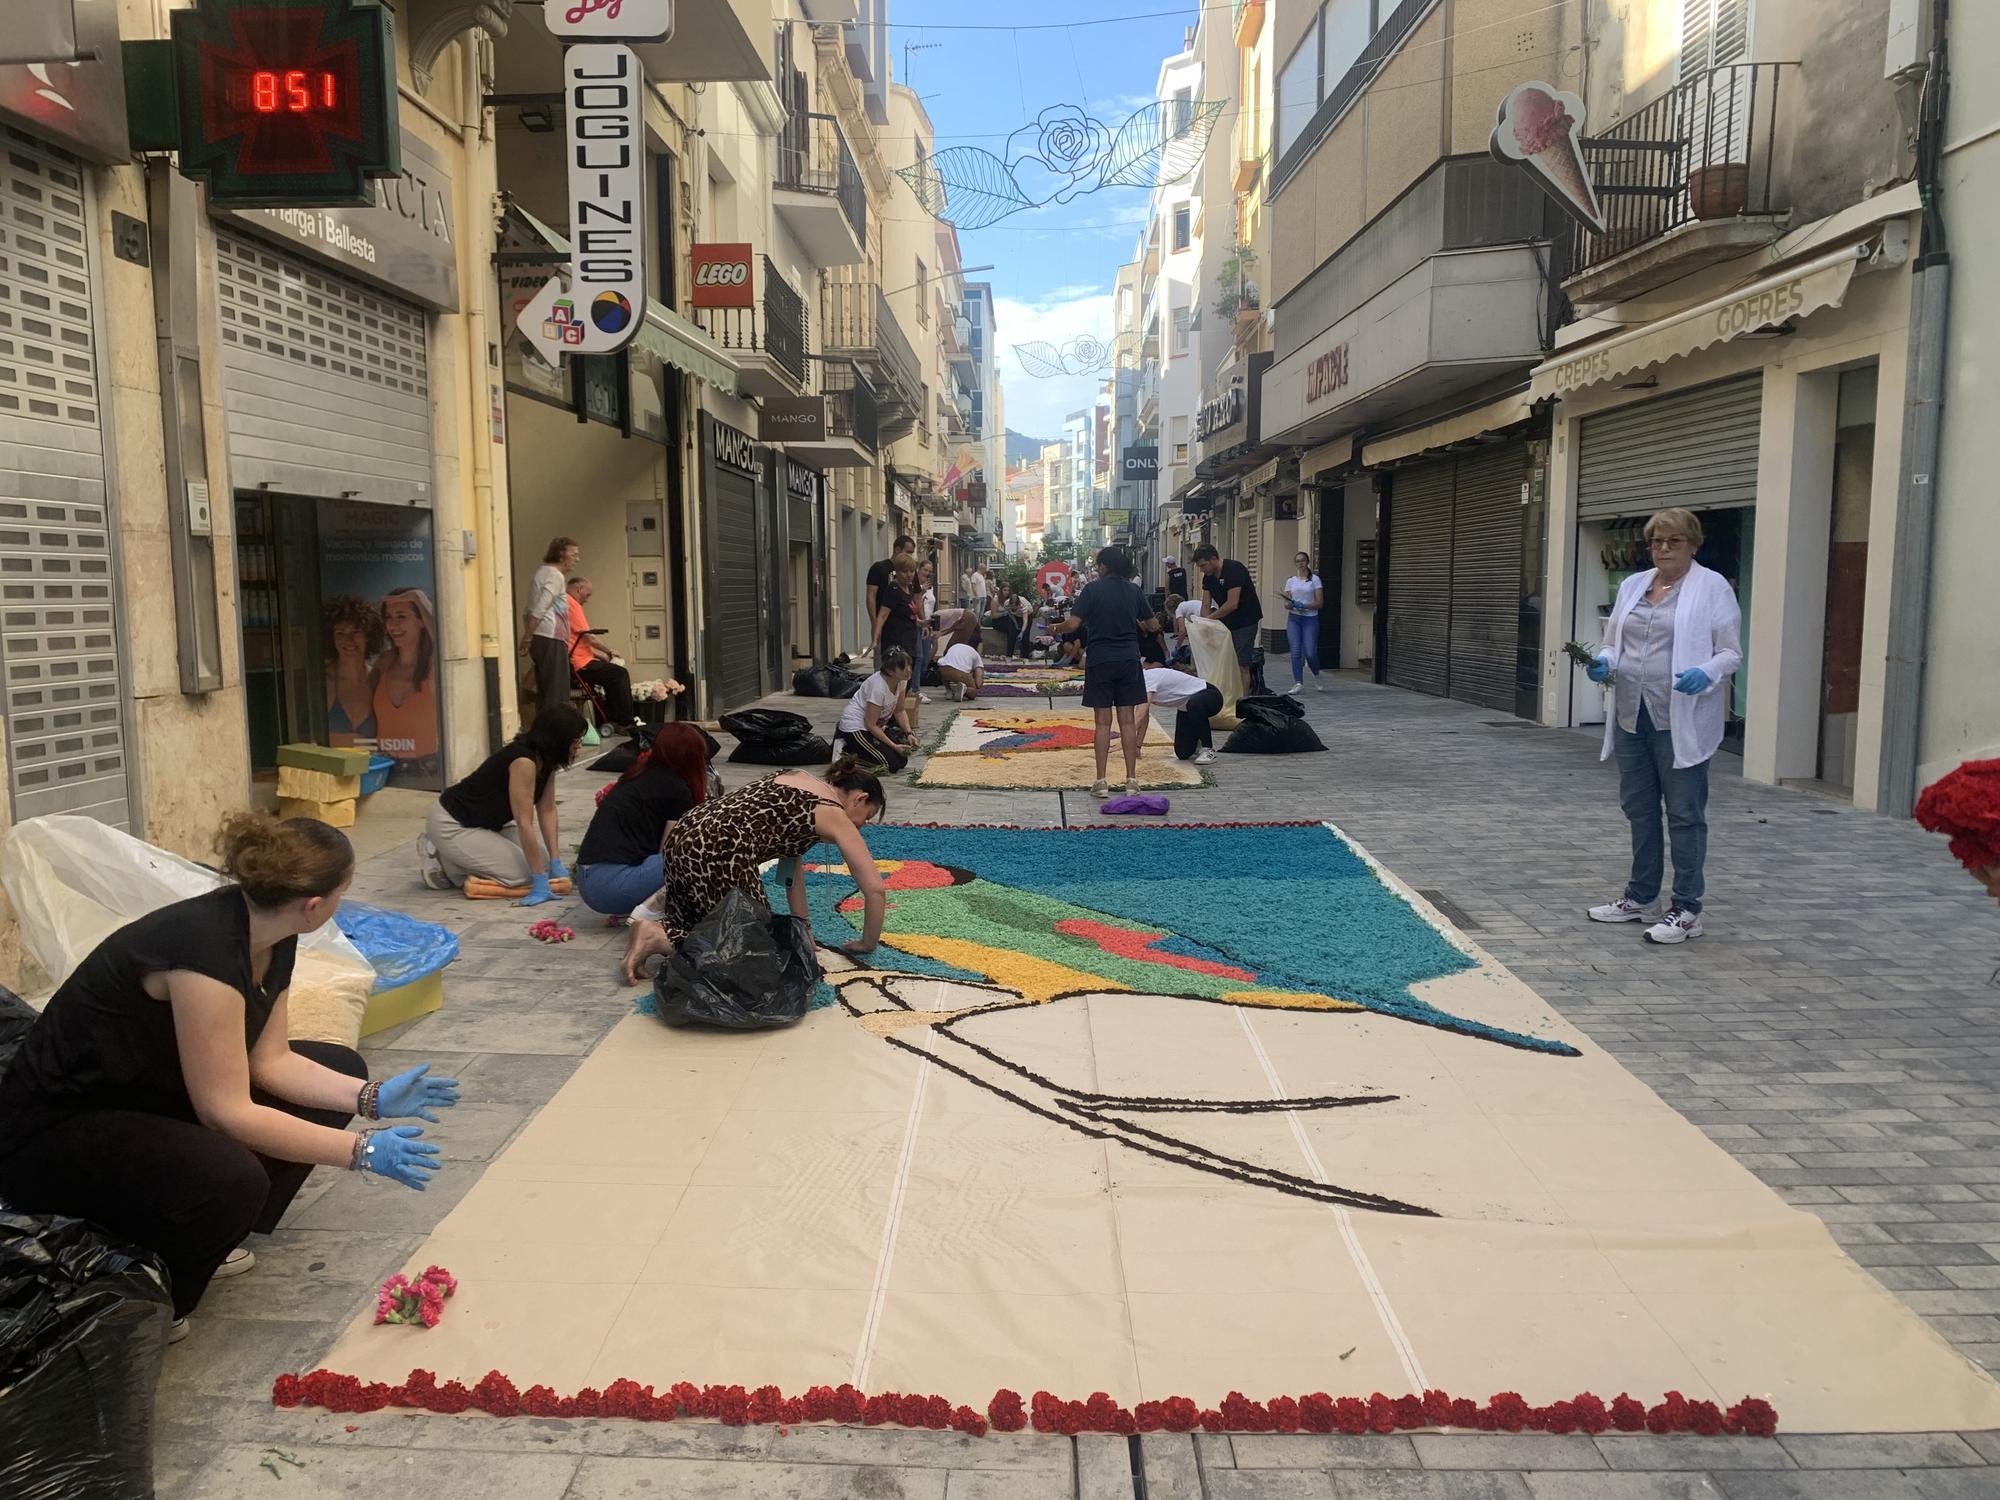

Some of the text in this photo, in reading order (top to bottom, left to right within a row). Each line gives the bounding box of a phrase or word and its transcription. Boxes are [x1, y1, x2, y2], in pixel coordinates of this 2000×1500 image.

[573, 54, 633, 283] JOGUINES
[325, 217, 376, 264] Ballesta
[695, 262, 749, 286] LEGO
[1716, 281, 1803, 337] GOFRES
[1555, 350, 1610, 389] CREPES
[771, 414, 817, 423] MANGO
[714, 422, 755, 471] MANGO
[788, 461, 816, 496] MANGO
[380, 738, 416, 751] ISDIN
